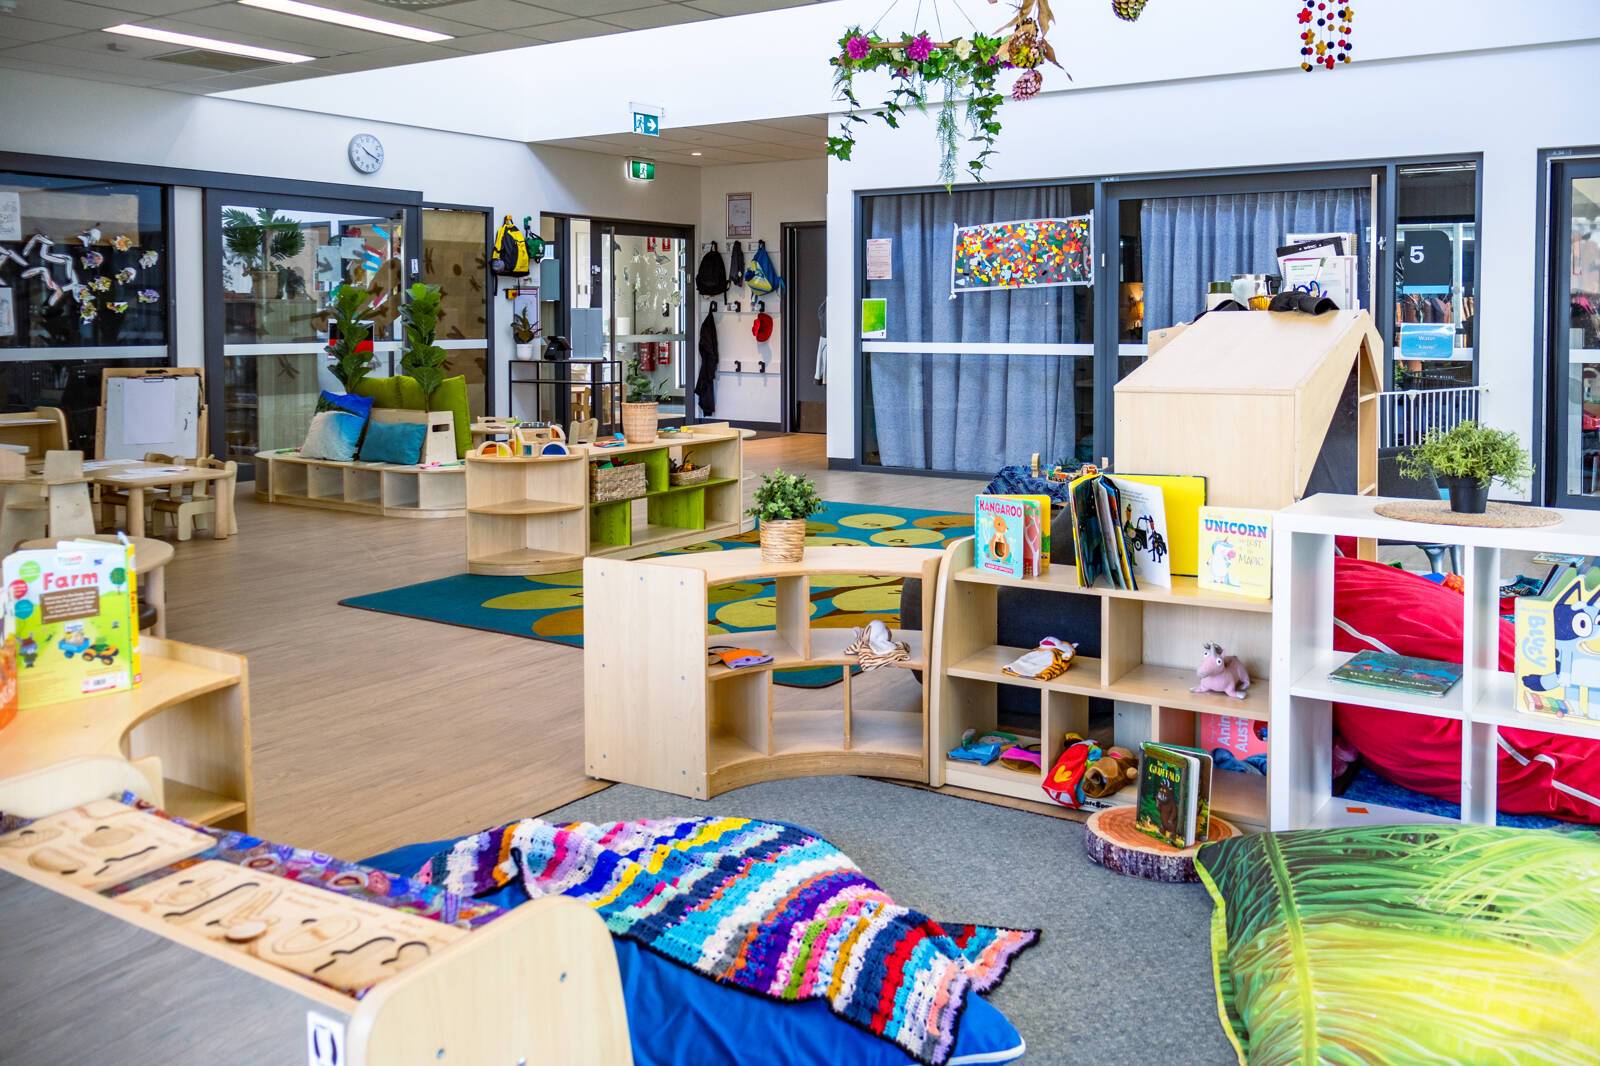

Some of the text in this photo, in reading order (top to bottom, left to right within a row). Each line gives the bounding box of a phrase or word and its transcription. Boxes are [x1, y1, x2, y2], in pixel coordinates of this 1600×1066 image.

[1410, 245, 1425, 263] 5
[980, 500, 1022, 518] KANGAROO
[1204, 519, 1267, 538] UNICORN
[43, 572, 98, 590] Farm
